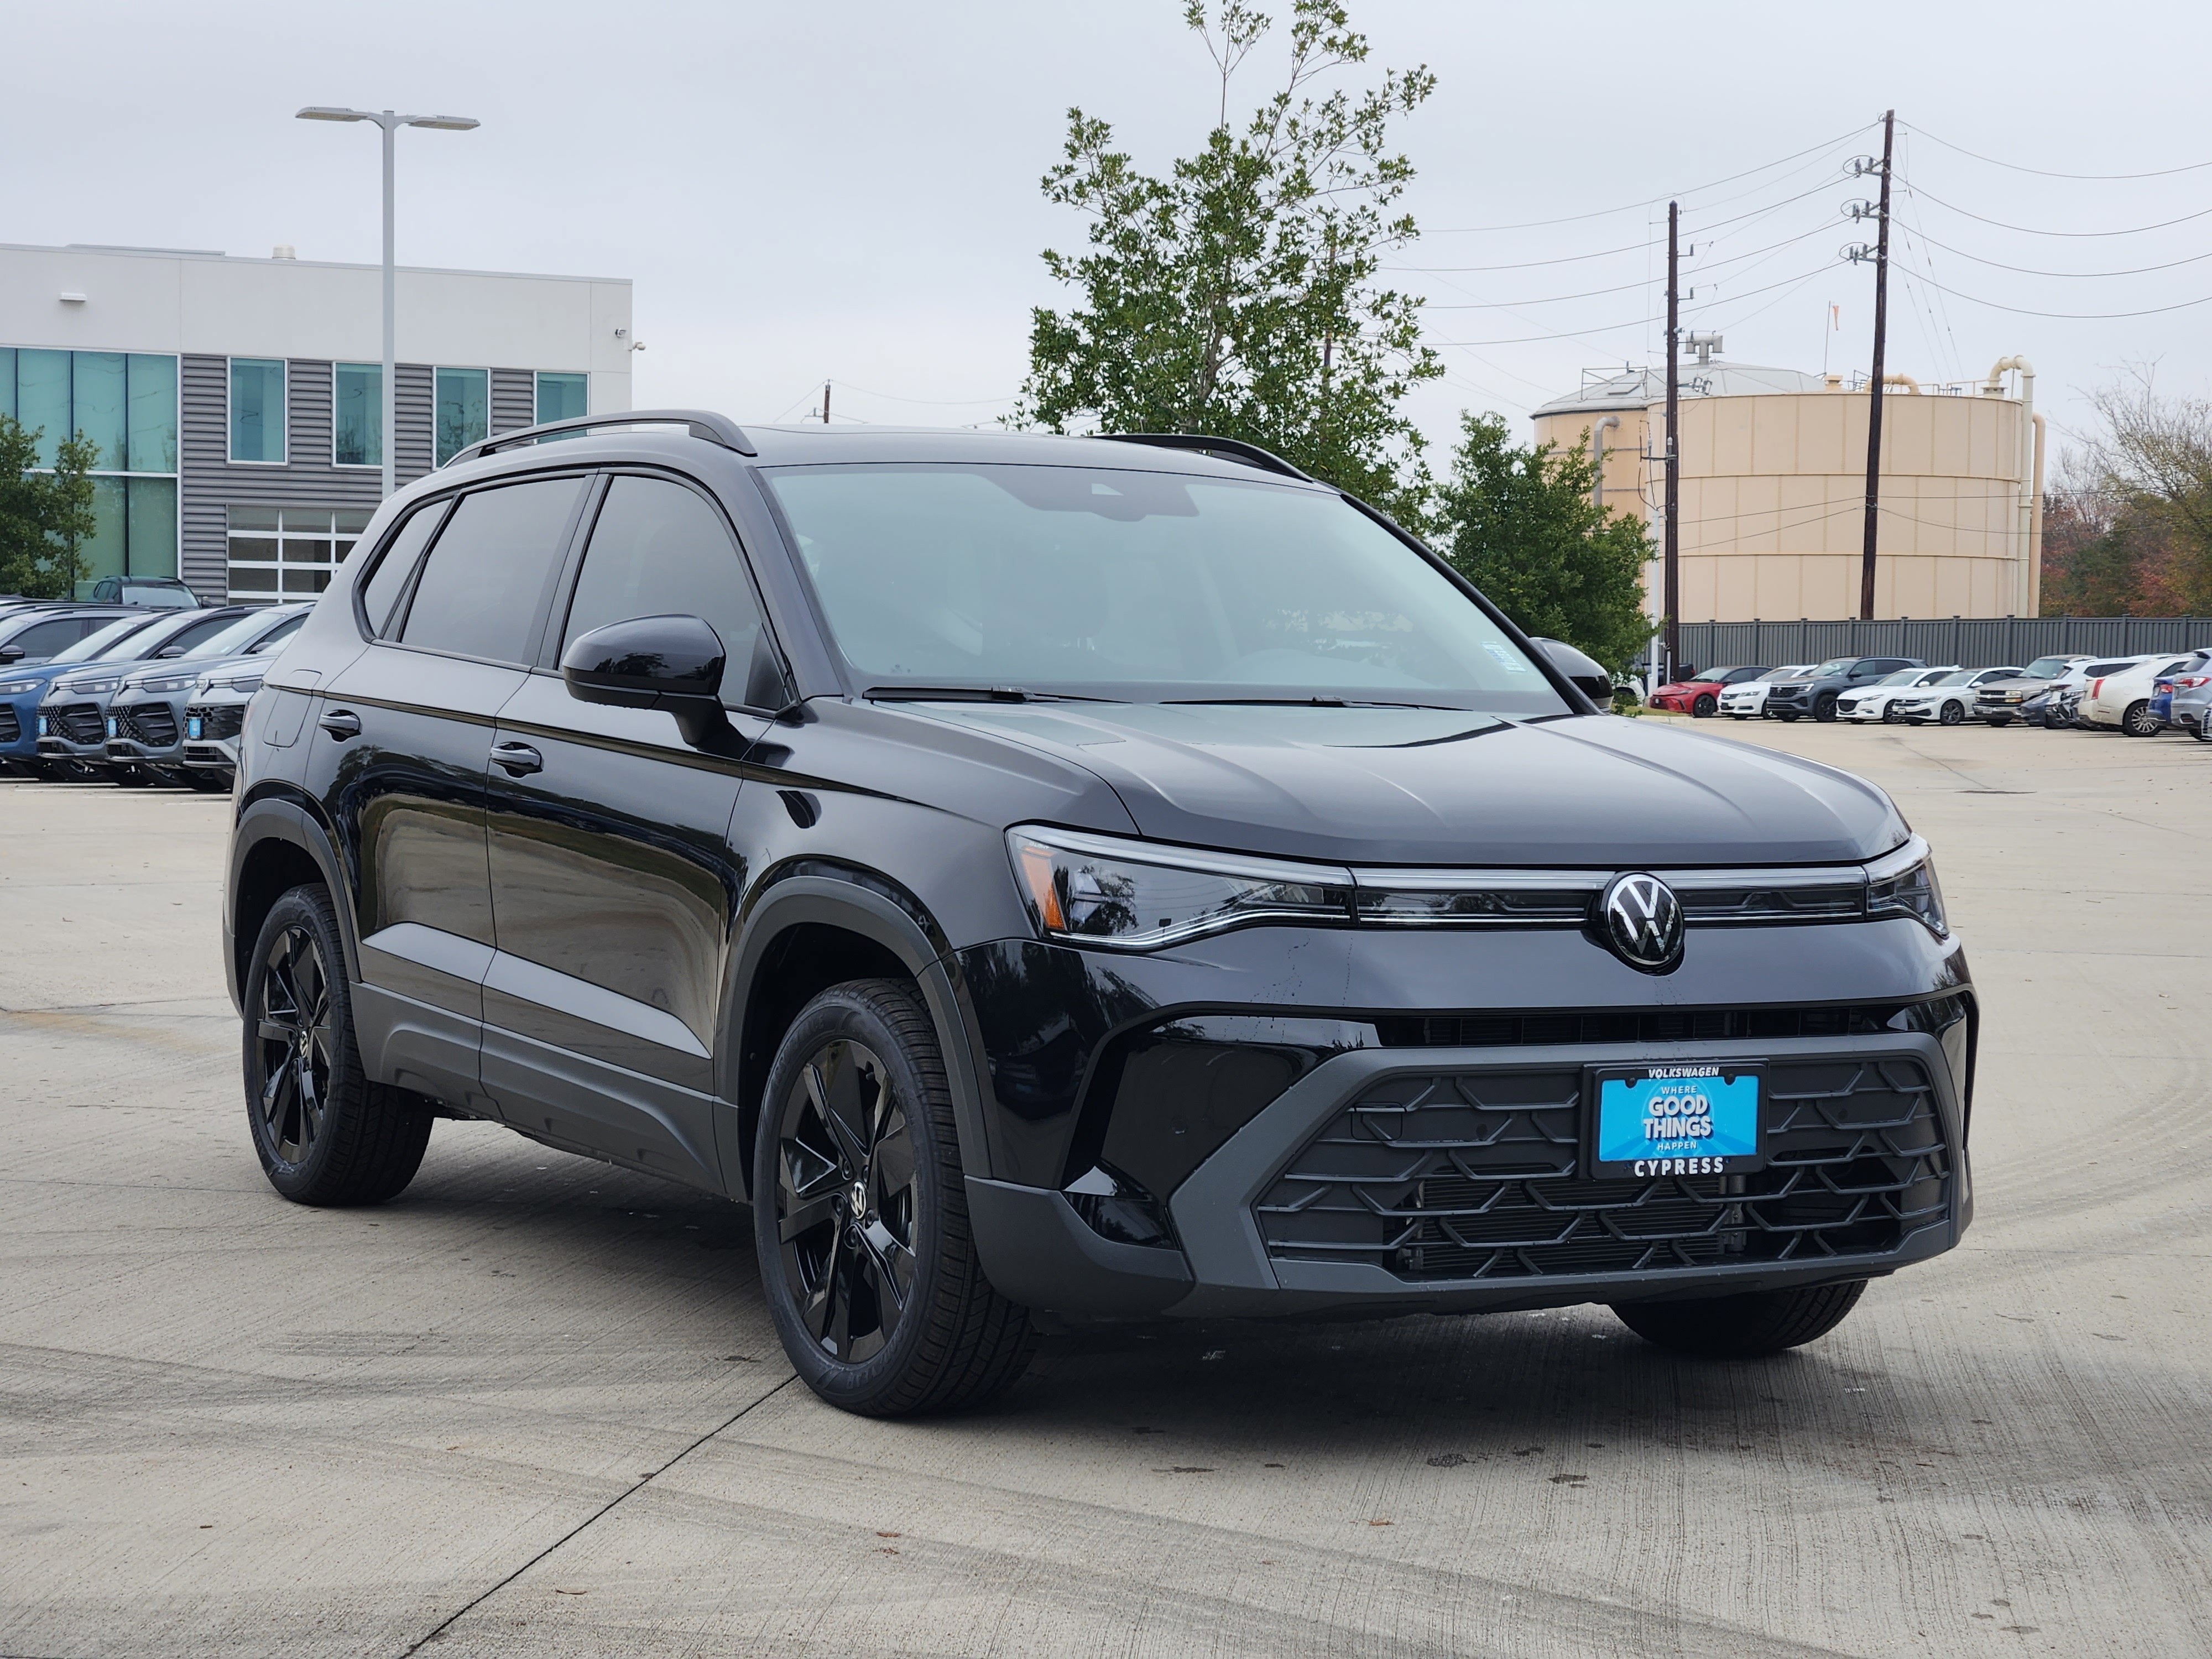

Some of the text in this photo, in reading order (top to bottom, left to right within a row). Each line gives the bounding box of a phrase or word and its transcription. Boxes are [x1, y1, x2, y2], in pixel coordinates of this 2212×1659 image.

[1648, 1067, 1719, 1078] VOLKSWAGEN
[1661, 1086, 1697, 1094] WHERE
[1648, 1095, 1709, 1117] GOOD
[1643, 1116, 1712, 1139] THINGS
[1657, 1141, 1697, 1151] HAPPEN
[1634, 1157, 1724, 1177] CYPRESS
